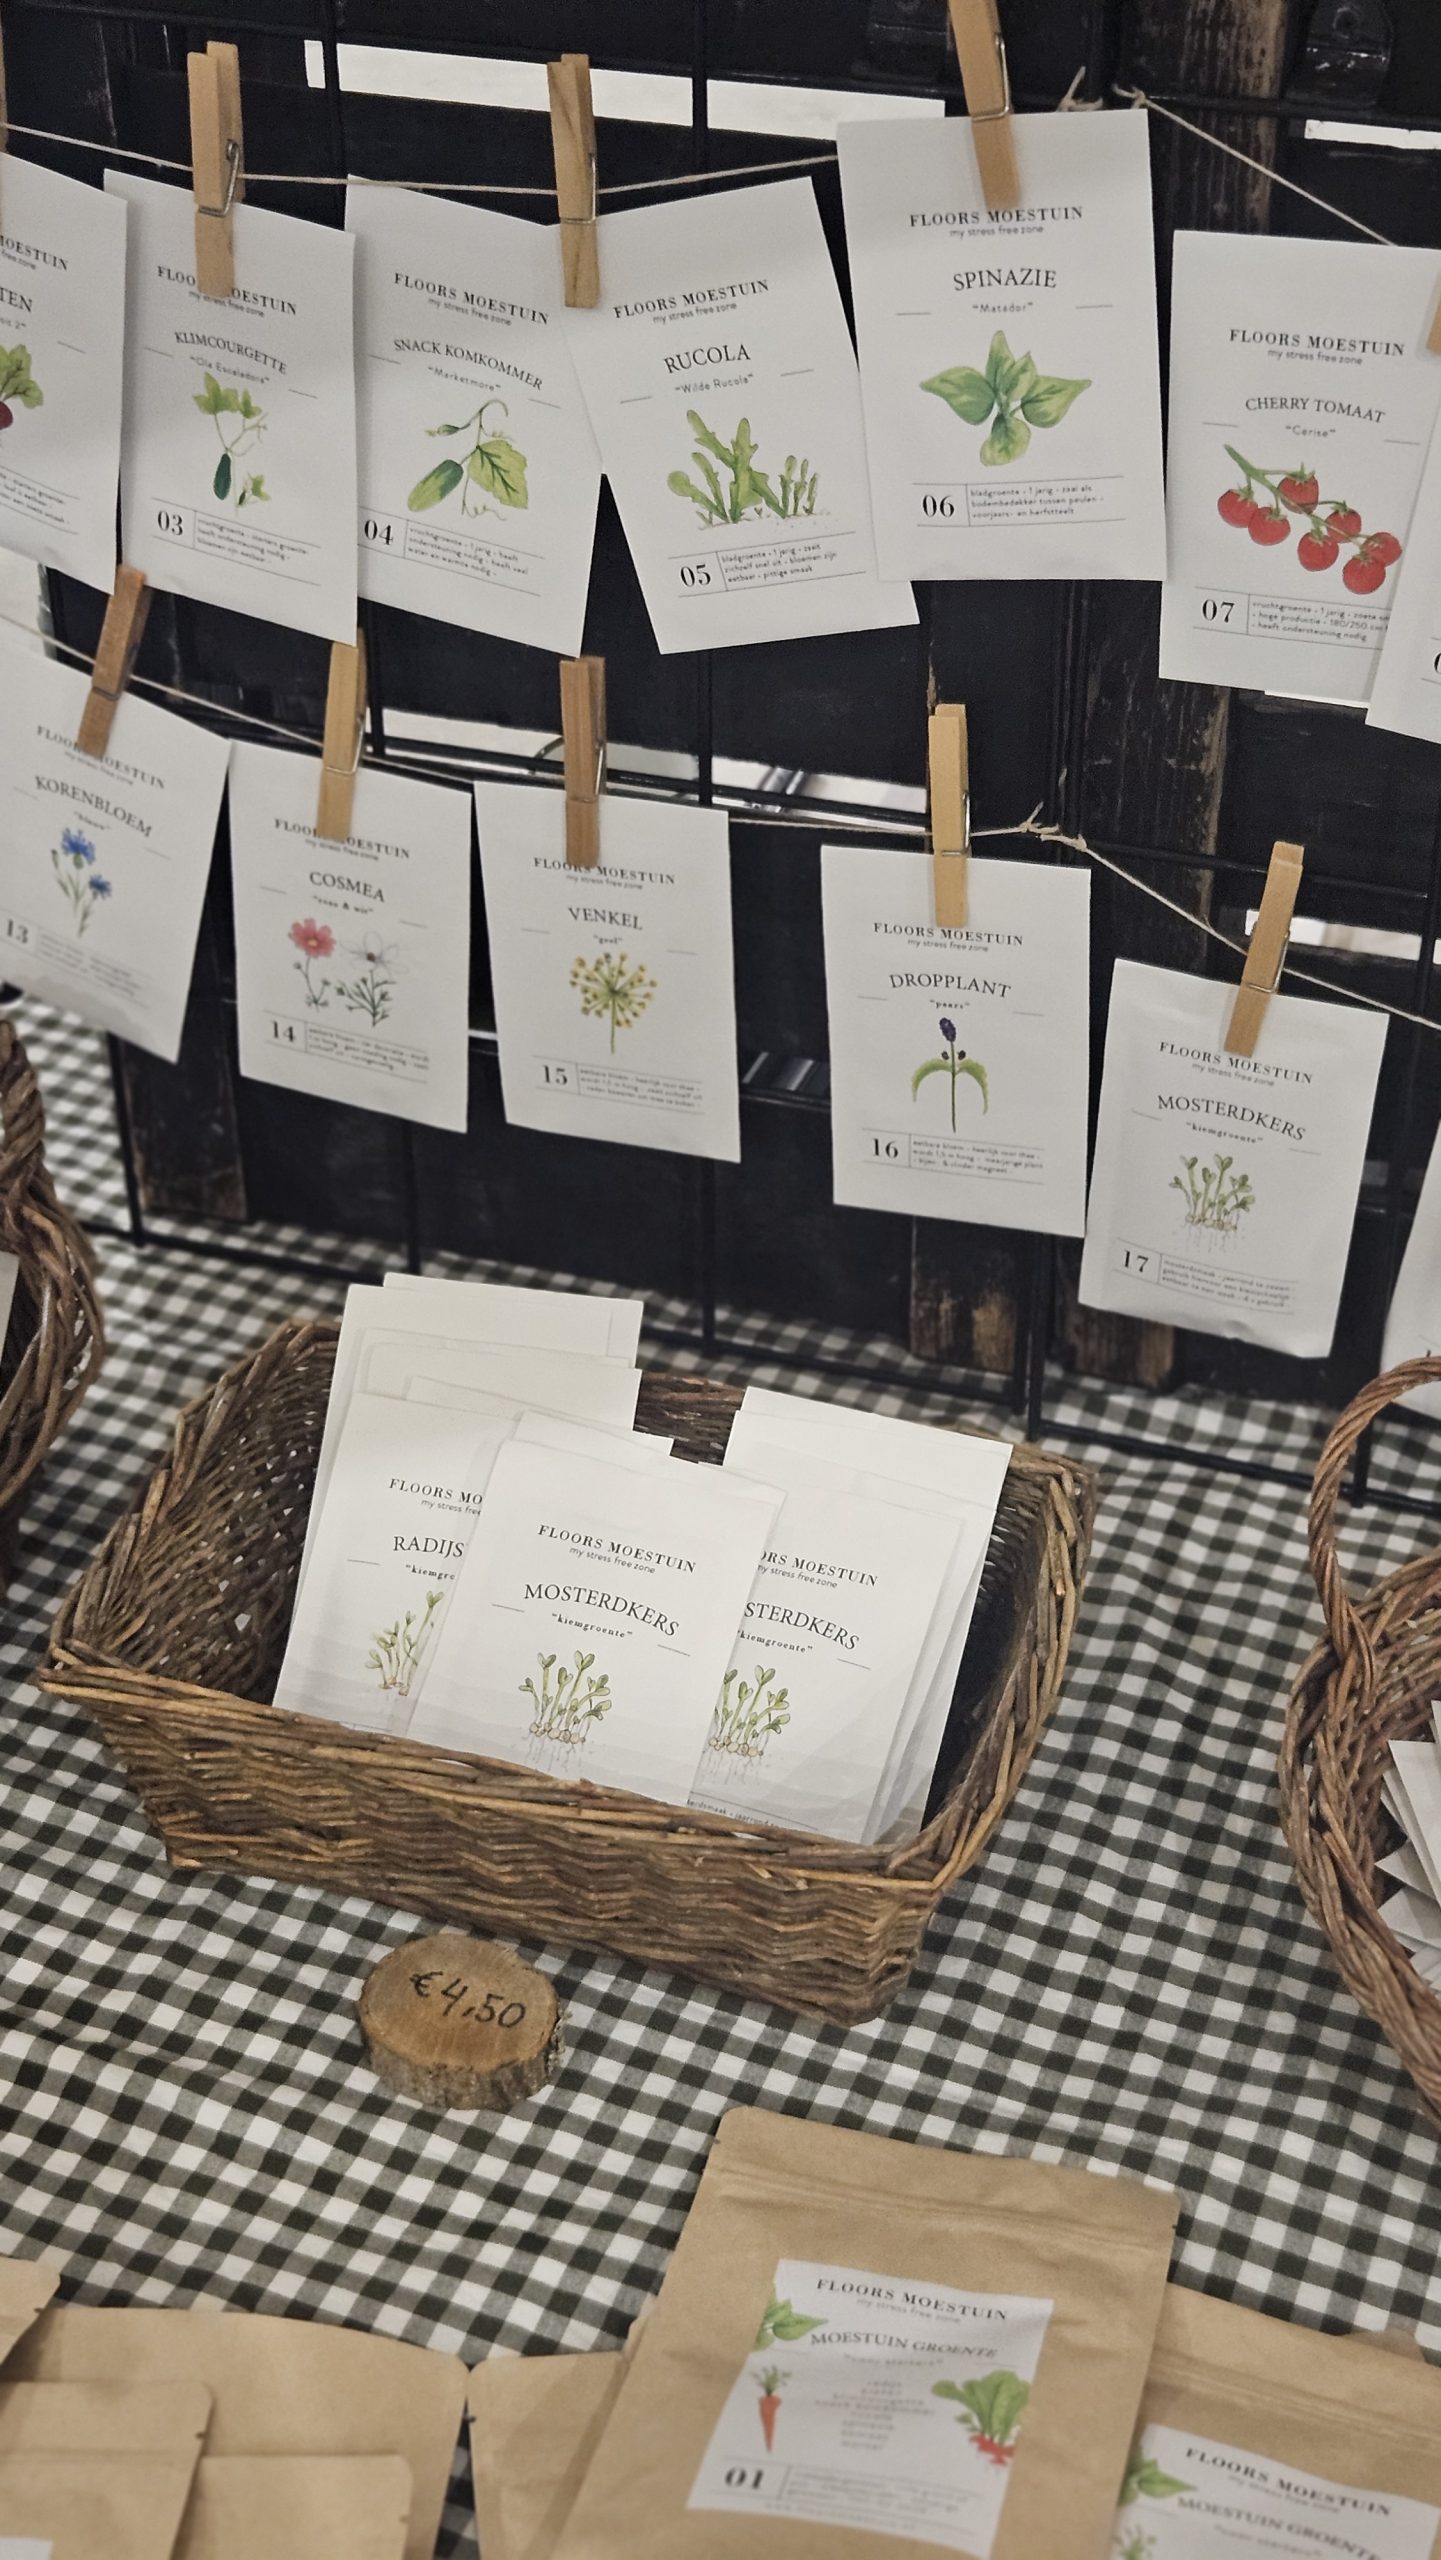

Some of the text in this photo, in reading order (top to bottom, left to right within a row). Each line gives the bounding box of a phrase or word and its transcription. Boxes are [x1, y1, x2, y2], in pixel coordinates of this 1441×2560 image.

[910, 206, 1083, 227] FLOORS MOESTUIN
[949, 225, 1044, 239] my stress free zone
[953, 267, 1057, 292] SPINAZIE
[231, 287, 297, 315] OESTUIN
[394, 273, 549, 325] FLOORS MOESTUIN
[613, 280, 769, 319] FLOORS MOESTUIN
[444, 302, 469, 315] stress
[471, 307, 490, 320] free
[490, 313, 513, 327] zone
[653, 302, 737, 325] my stress free zone
[175, 332, 288, 375] KLIMCOURGETTE
[1229, 329, 1405, 356] FLOORS MOESTUIN
[394, 339, 542, 390] SNACK KOMKOMMER
[664, 343, 751, 373] RUCOLA
[1267, 349, 1363, 365] my stress free zone
[1245, 397, 1386, 423] CHERRY TOMAAT
[922, 494, 955, 518] 06
[157, 510, 184, 536] 03
[364, 519, 394, 546] 04
[680, 563, 711, 588] 05
[1202, 599, 1236, 624] 07
[101, 757, 164, 789] OESTUIN
[35, 776, 152, 838] KORENBLOEM
[346, 836, 410, 858] OESTUIN
[309, 872, 385, 903] COSMEA
[597, 865, 675, 885] MOESTUIN
[568, 907, 643, 930] VENKEL
[873, 922, 1023, 946] FLOORS MOESTUIN
[907, 939, 988, 952] my stress free zone
[889, 973, 1012, 998] DROPPLANT
[273, 1020, 296, 1042] 14
[543, 1065, 568, 1085] 15
[1160, 1041, 1313, 1084] FLOORS MOESTUIN
[1207, 1066, 1232, 1078] stress
[1234, 1071, 1252, 1082] free
[1158, 1095, 1306, 1141] MOSTERDKERS
[872, 1137, 899, 1159] 16
[1124, 1250, 1149, 1273] 17
[389, 1478, 453, 1500] FLOORS
[421, 1499, 435, 1509] my
[438, 1502, 462, 1513] stress
[393, 1535, 465, 1559] RADIJS
[538, 1524, 696, 1573] FLOORS MOESTUIN
[405, 1564, 455, 1581] “kiemgro
[569, 1547, 655, 1574] my stress free zone
[792, 1557, 878, 1586] MOESTUIN
[770, 1567, 795, 1578] stress
[797, 1572, 815, 1584] free
[816, 1577, 838, 1589] zone
[524, 1583, 679, 1637] MOSTERDKERS
[744, 1601, 860, 1650] STERDKERS
[409, 1970, 526, 2028] €4,50
[816, 2279, 1008, 2321] FLOORS MOESTUIN
[811, 2331, 998, 2358] MOESTUIN GROENTE
[724, 2466, 764, 2490] 01
[1186, 2447, 1269, 2482] FLOORS
[1277, 2478, 1392, 2517] MOESTUIN
[1178, 2496, 1282, 2531] MOESTUIN
